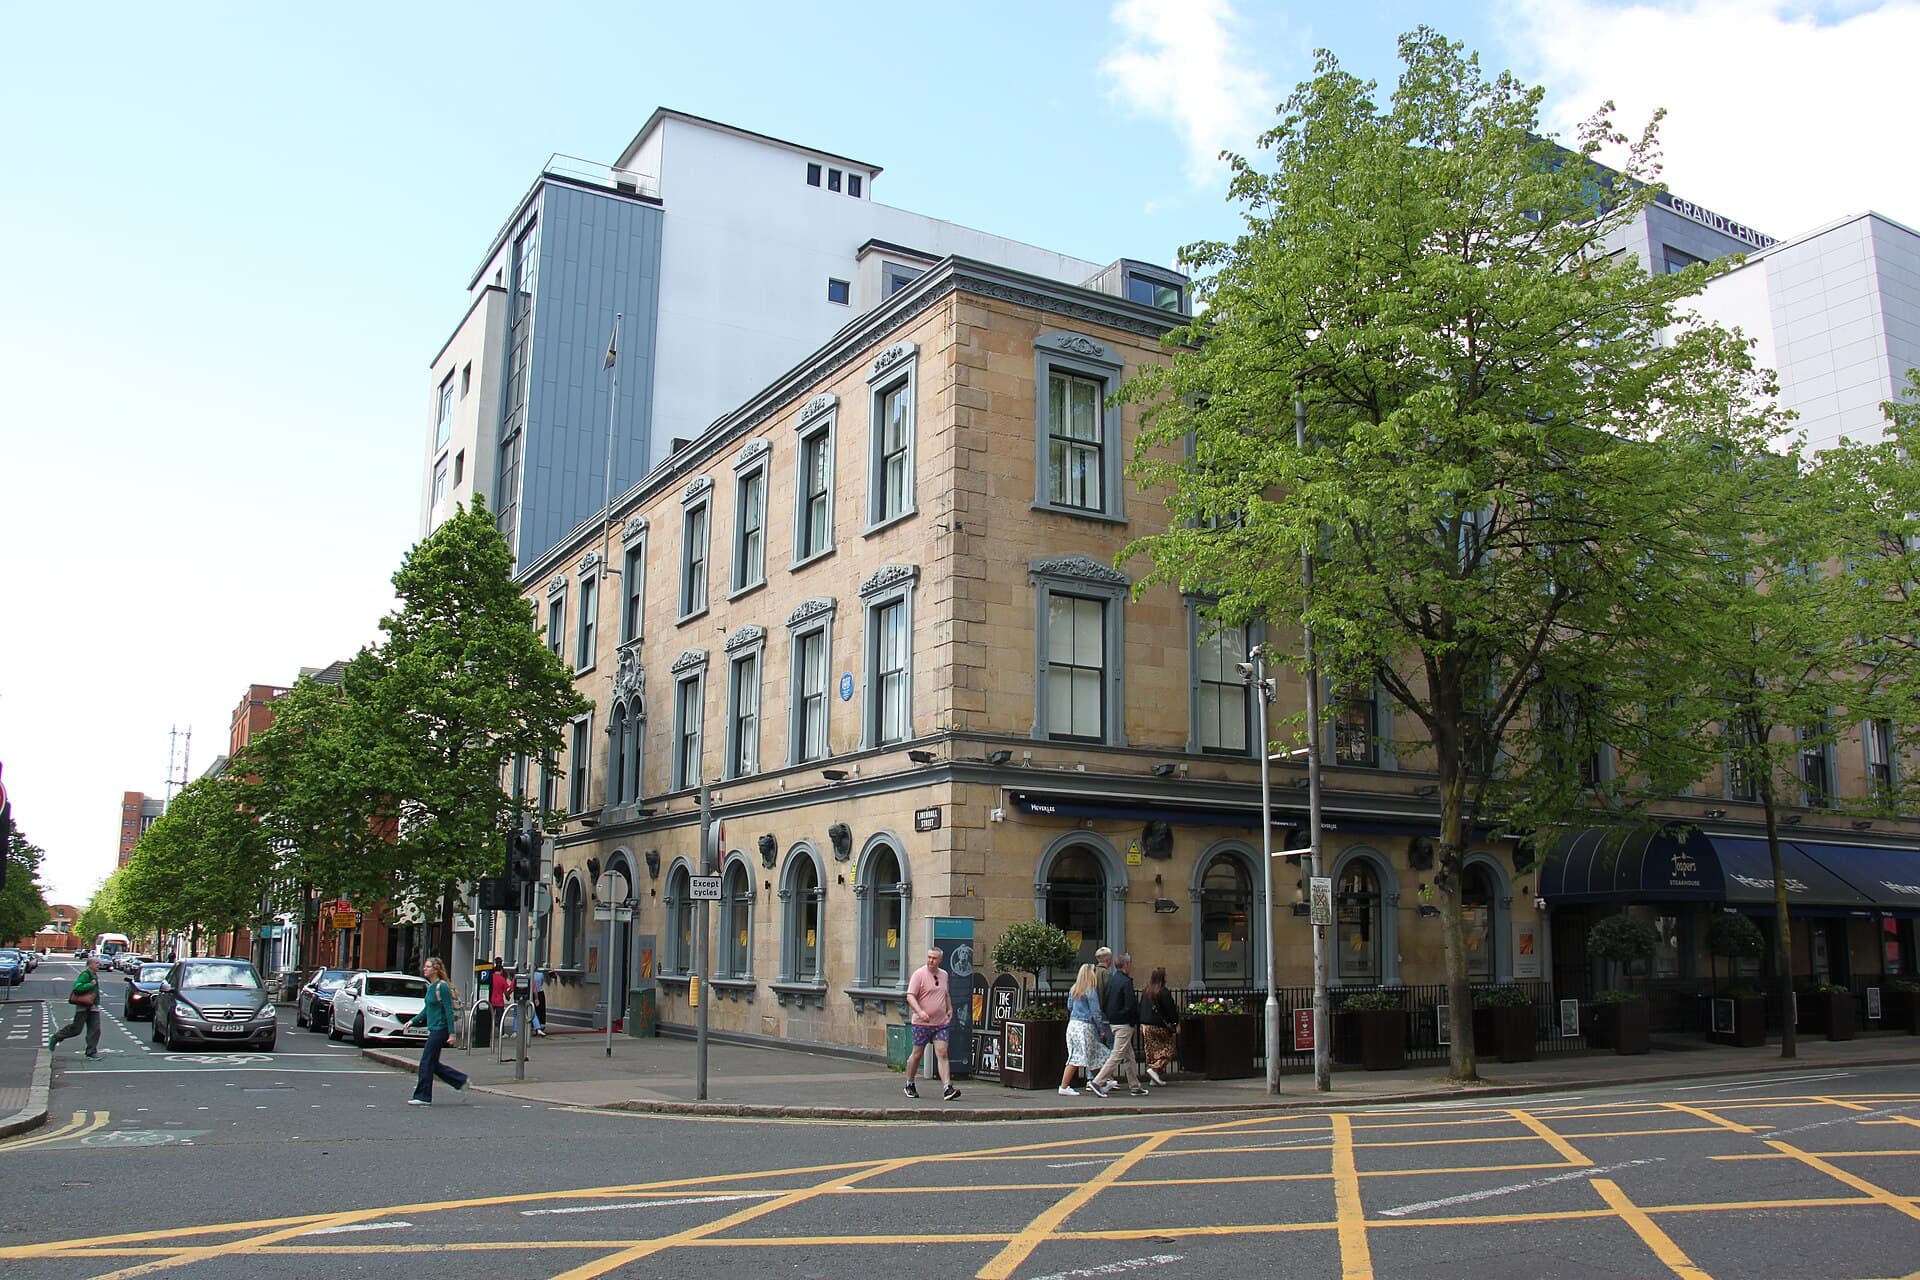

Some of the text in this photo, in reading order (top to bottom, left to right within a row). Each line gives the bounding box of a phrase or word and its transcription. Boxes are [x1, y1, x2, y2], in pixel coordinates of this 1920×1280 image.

[1671, 197, 1779, 248] GRAND CENTR
[920, 818, 934, 828] STREET
[693, 880, 719, 888] Except
[999, 992, 1010, 1006] THE
